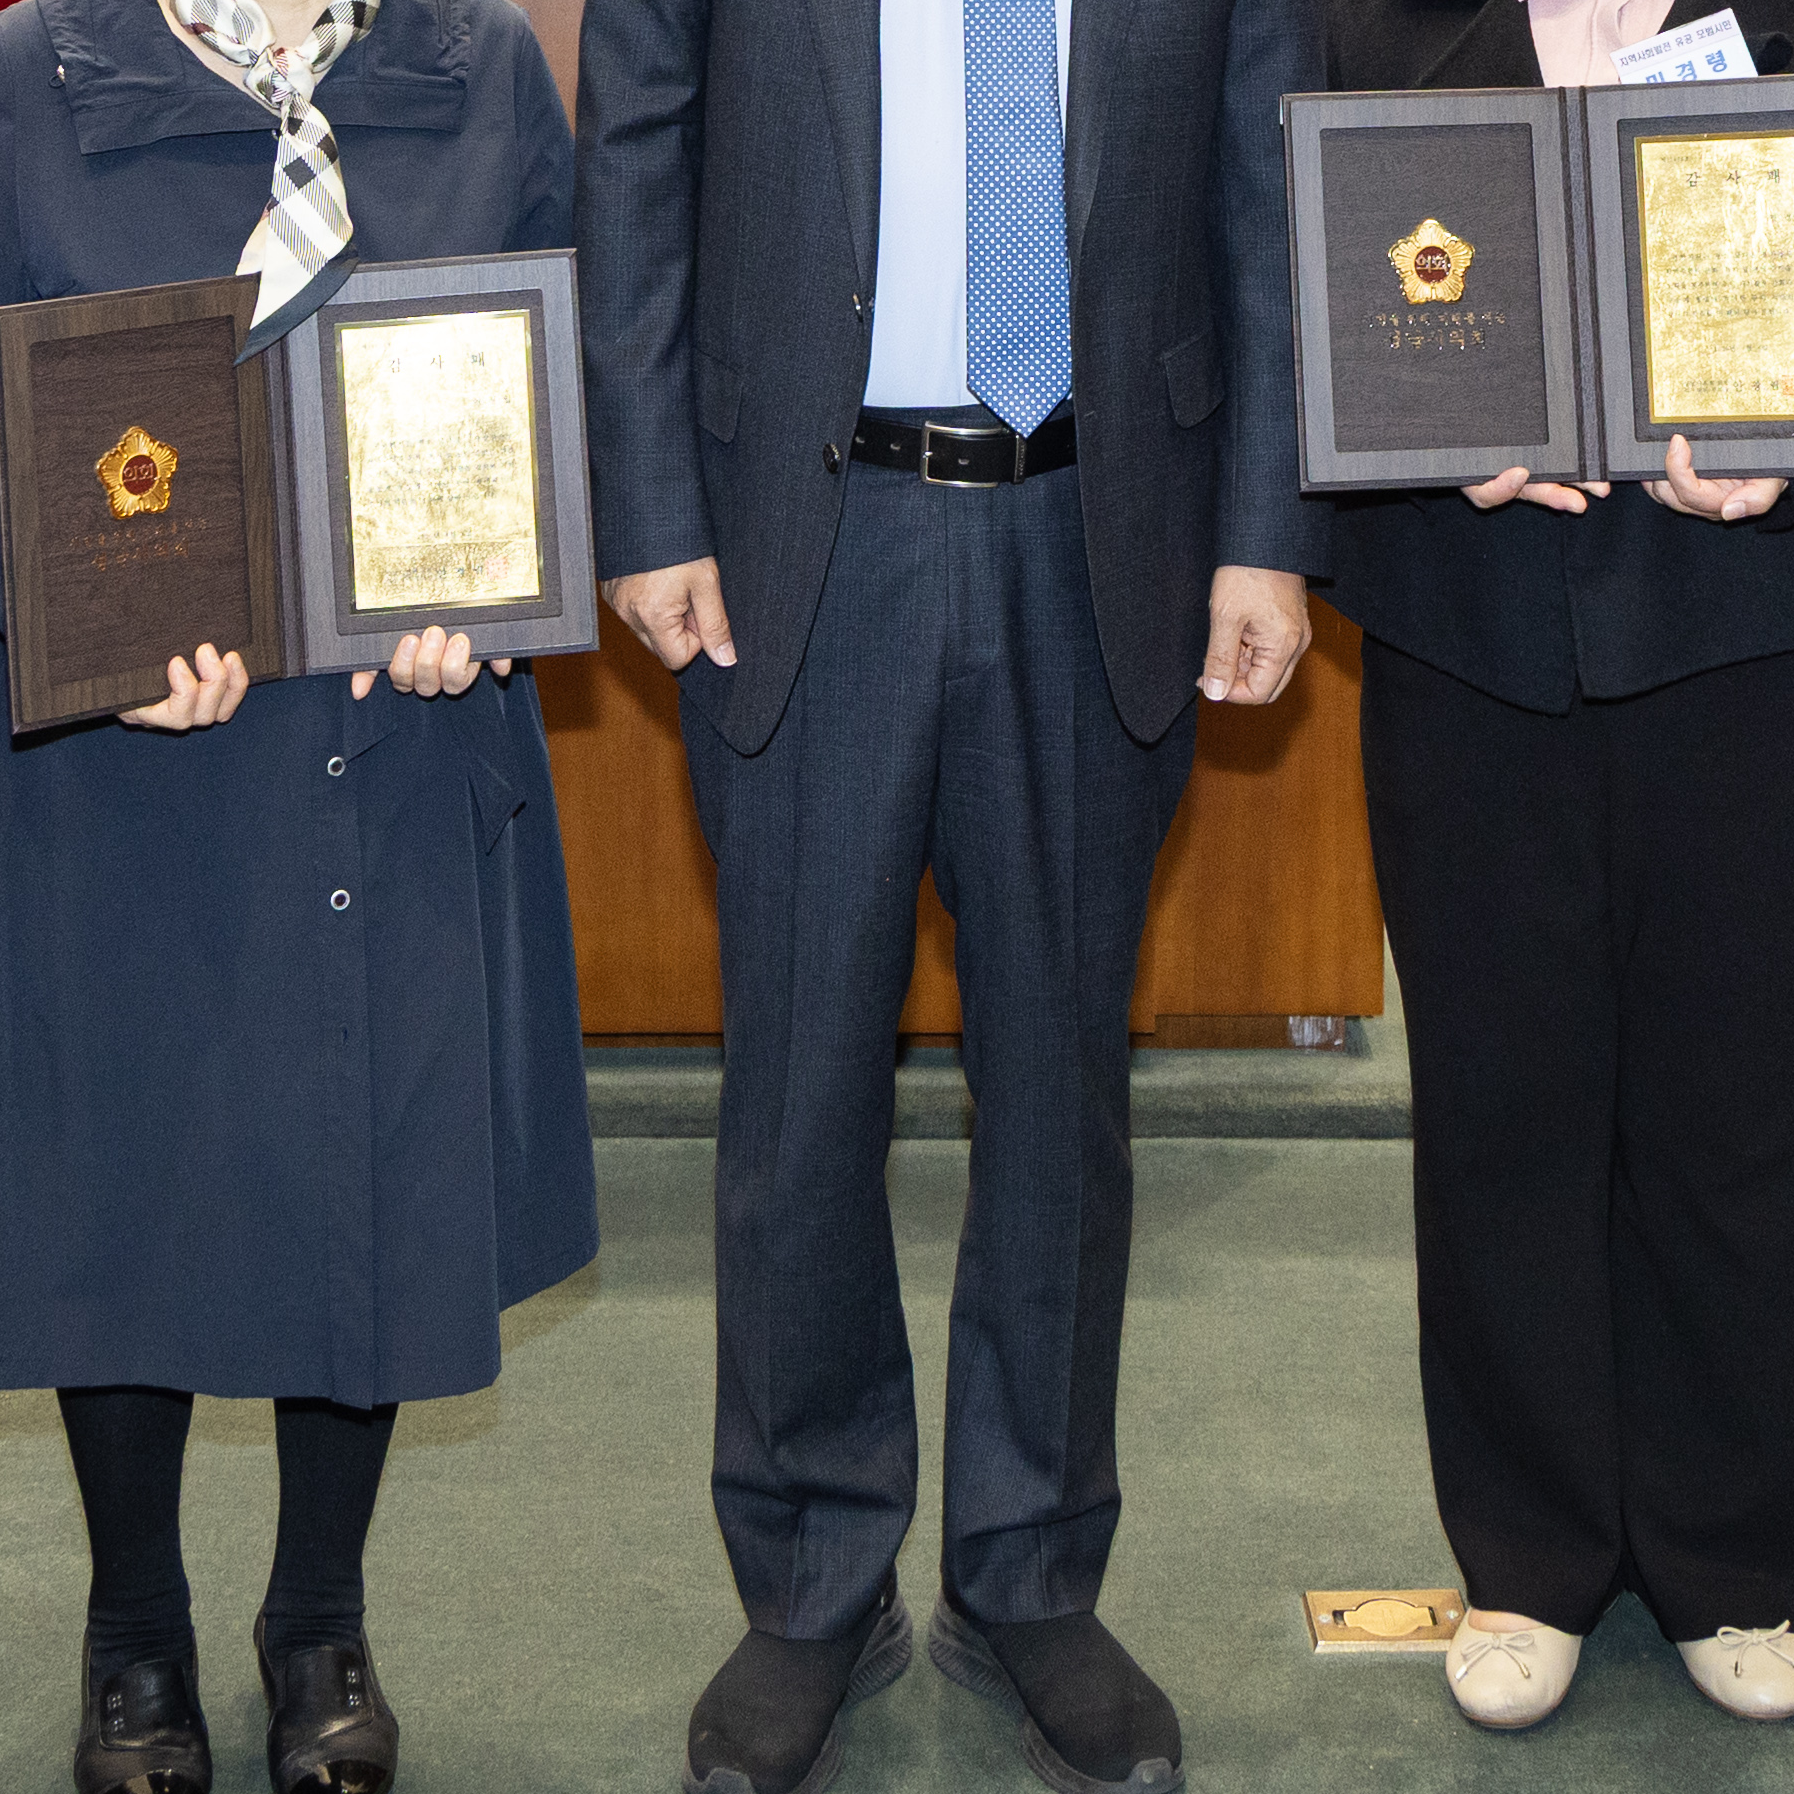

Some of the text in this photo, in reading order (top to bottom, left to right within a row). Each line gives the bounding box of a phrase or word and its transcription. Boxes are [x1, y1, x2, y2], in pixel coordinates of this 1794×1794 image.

[1619, 19, 1733, 68] 지역사회발전 유공 모범시민
